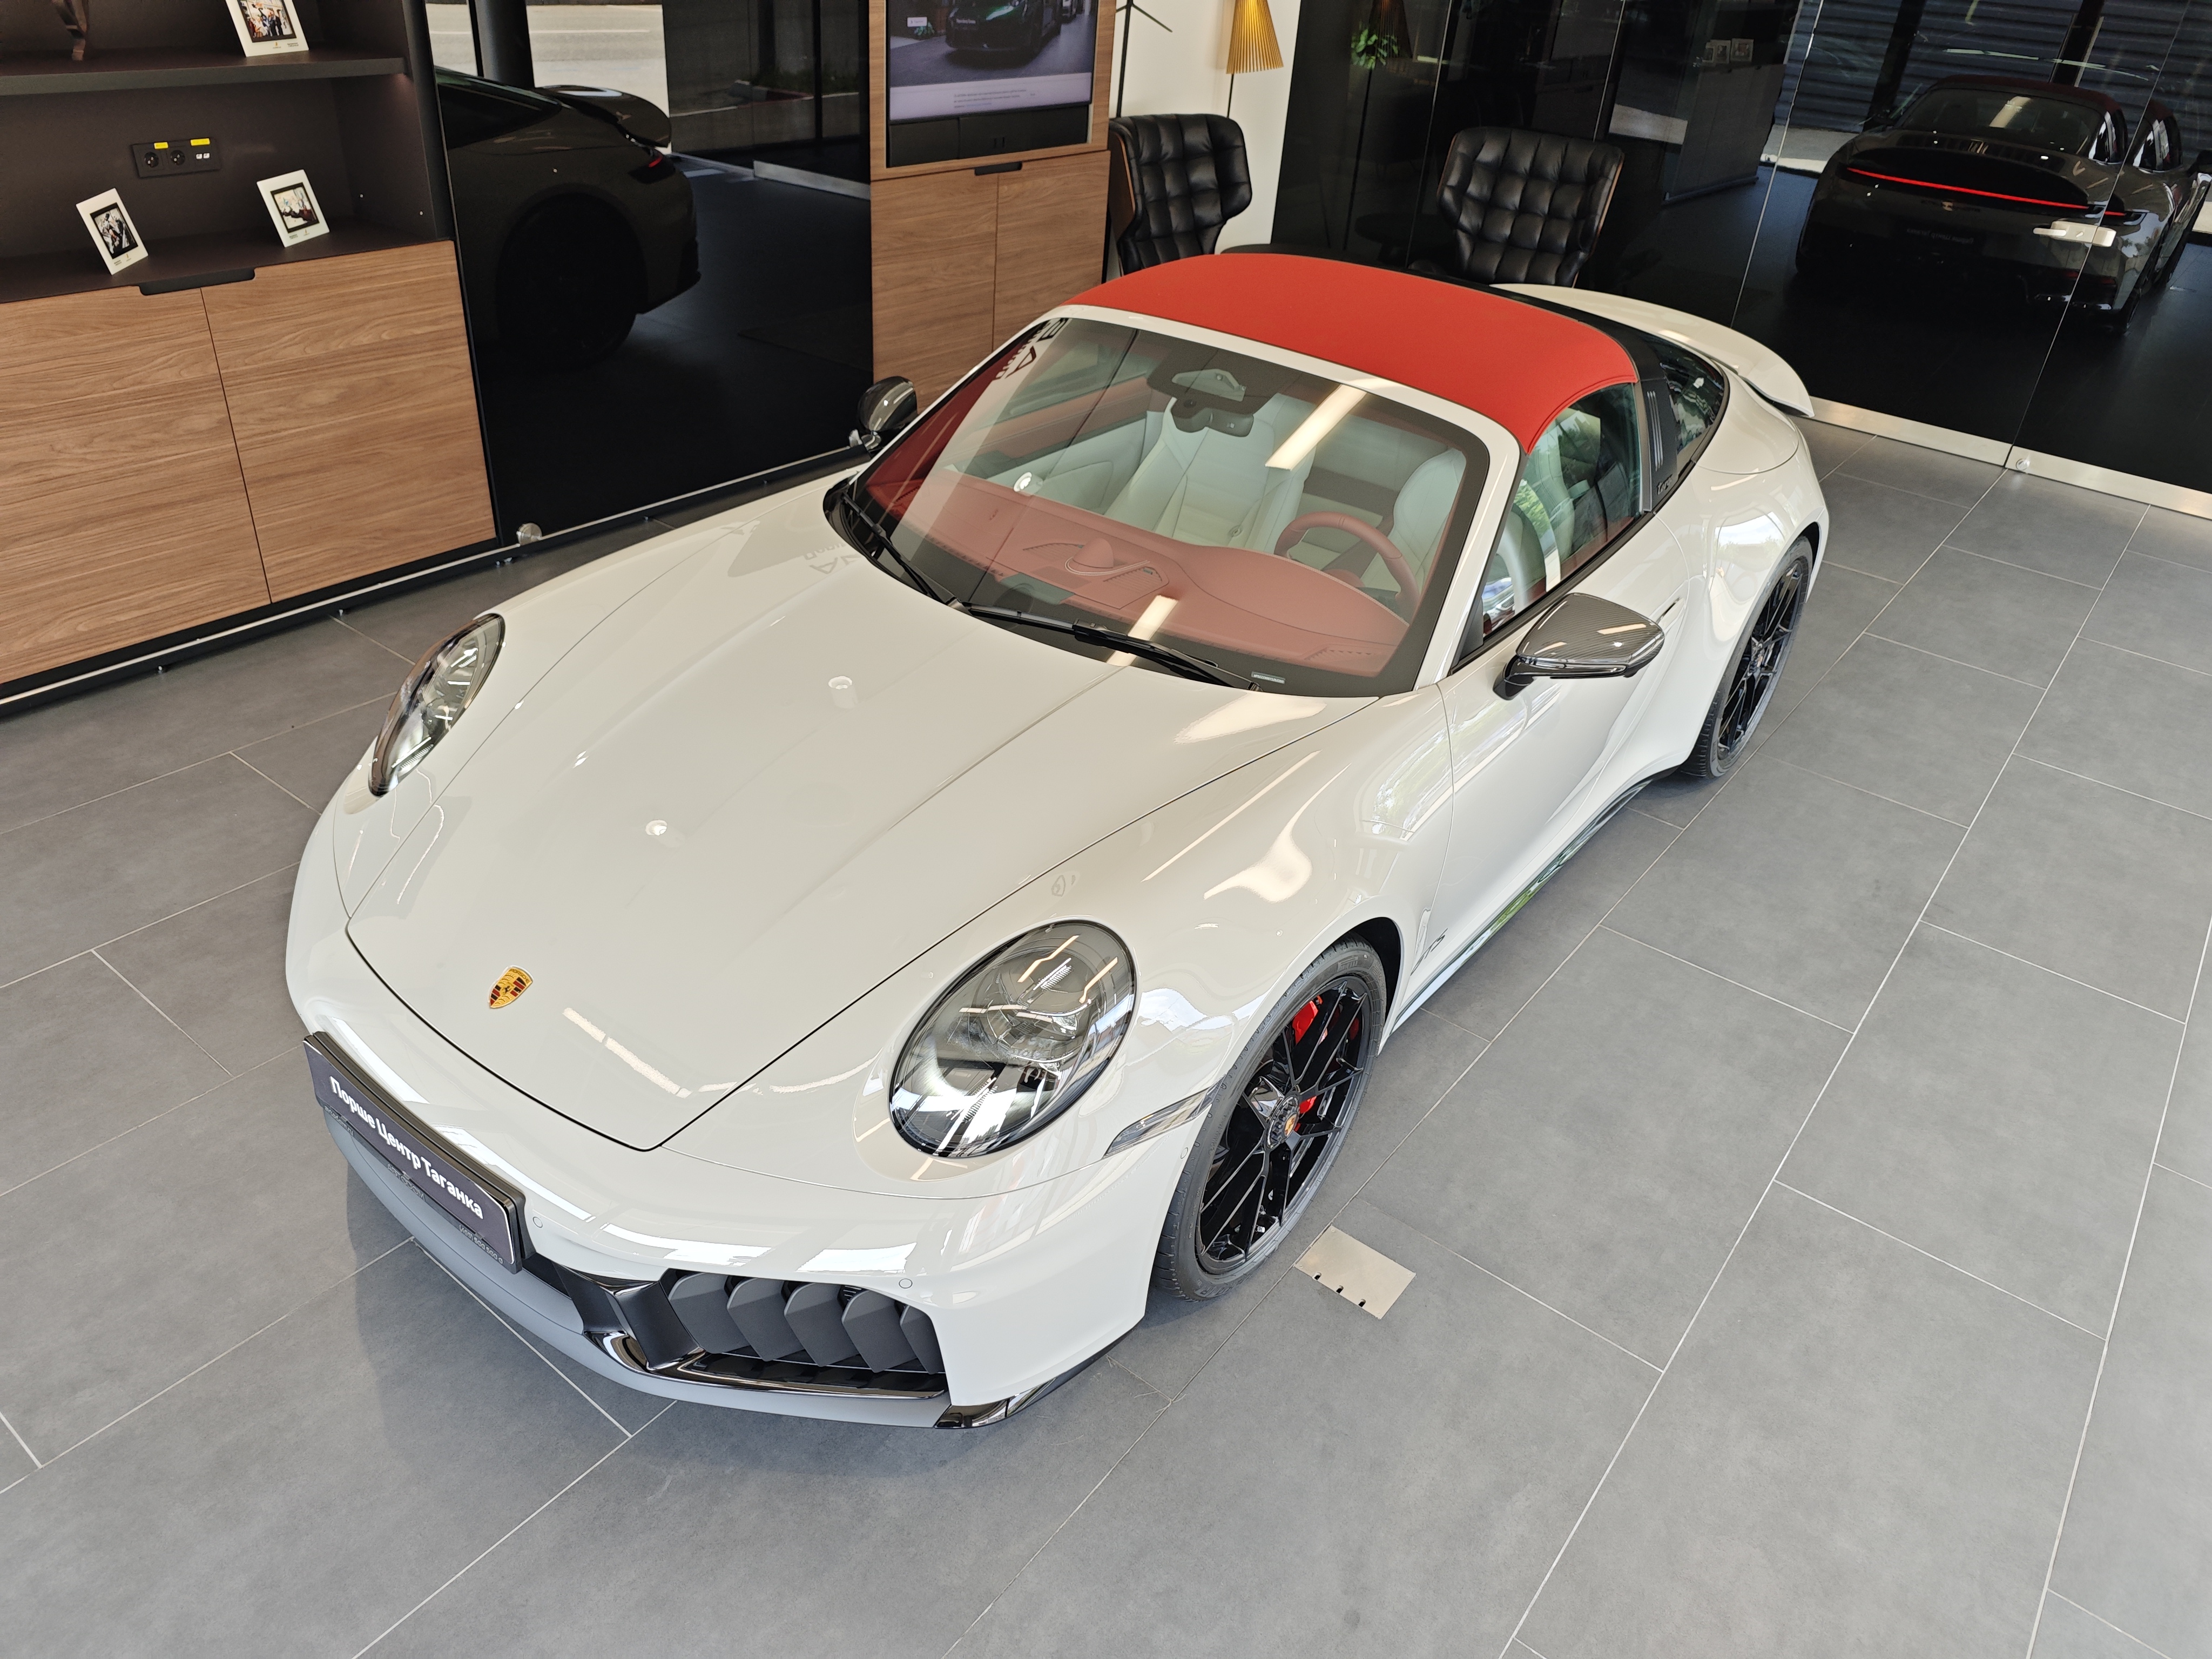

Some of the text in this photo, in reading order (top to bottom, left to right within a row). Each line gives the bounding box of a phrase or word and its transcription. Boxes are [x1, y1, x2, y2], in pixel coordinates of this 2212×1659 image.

[509, 968, 530, 984] PORSCHE
[330, 1076, 484, 1219] Порше Центр Таганка
